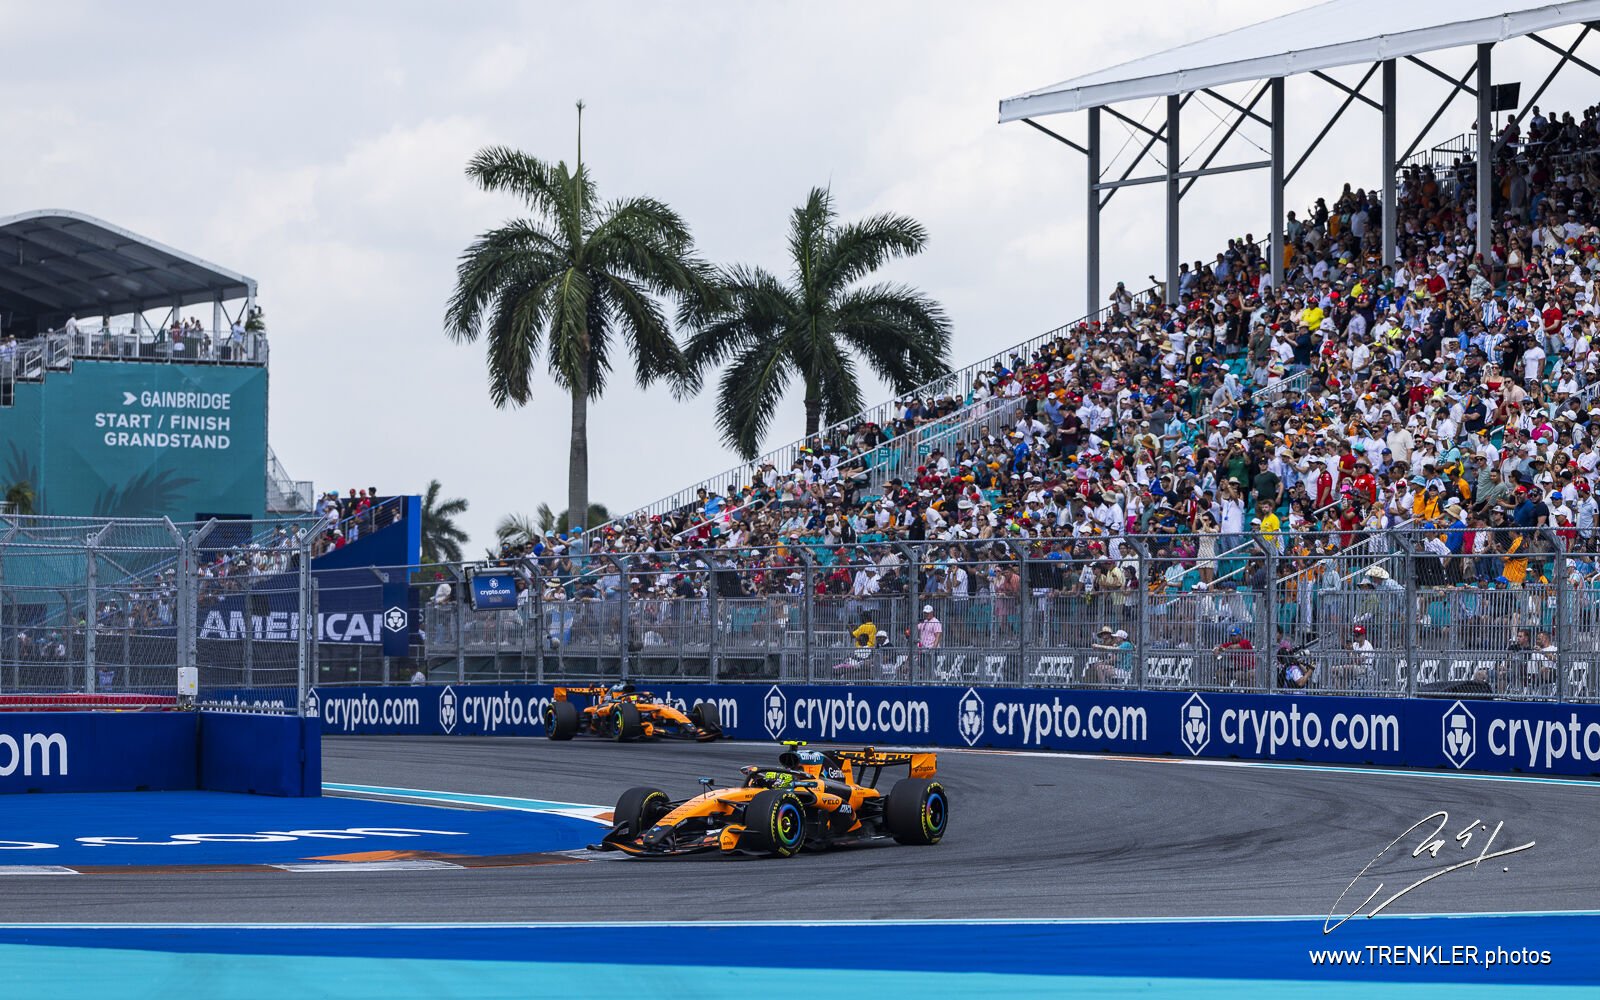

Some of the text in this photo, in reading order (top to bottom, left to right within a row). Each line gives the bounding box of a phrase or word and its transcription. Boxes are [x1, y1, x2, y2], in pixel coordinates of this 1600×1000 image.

[140, 391, 231, 410] GAINBRIDGE
[95, 412, 231, 431] START / FINISH
[104, 431, 231, 450] GRANDSTAND
[480, 589, 511, 597] crypto.com
[324, 693, 420, 731] crypto.com
[462, 690, 556, 732] crypto.co
[793, 692, 929, 738] crypto.com
[992, 696, 1148, 745] crypto.com
[1220, 703, 1400, 755] crypto.com
[1487, 713, 1600, 768] crypto
[822, 798, 840, 806] VELO
